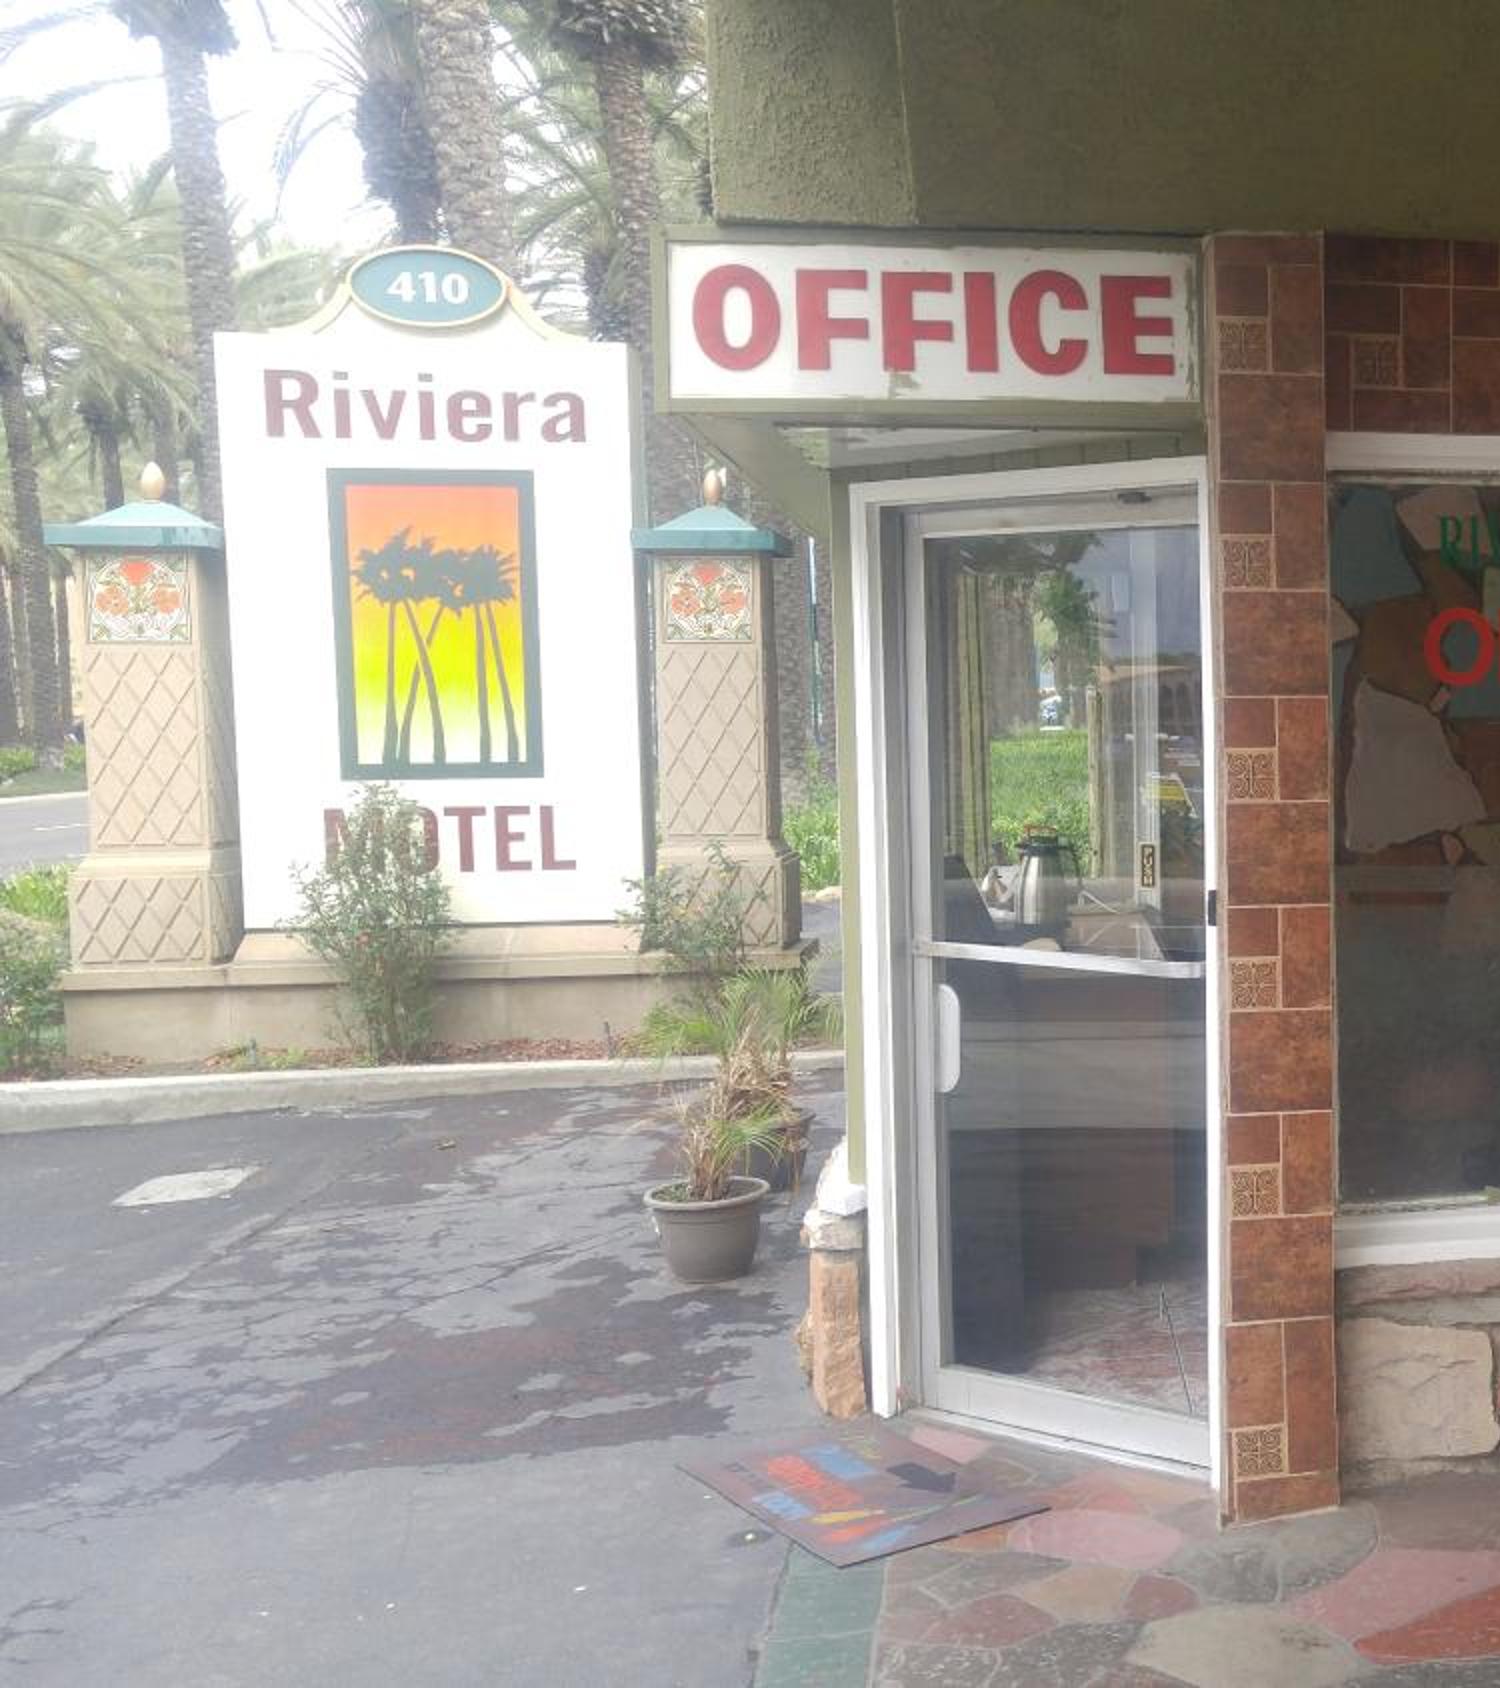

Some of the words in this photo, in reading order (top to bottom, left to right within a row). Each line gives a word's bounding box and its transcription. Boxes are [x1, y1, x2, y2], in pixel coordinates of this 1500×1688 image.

[387, 272, 469, 307] 410
[692, 263, 1176, 377] OFFICE
[263, 369, 588, 443] Riviera
